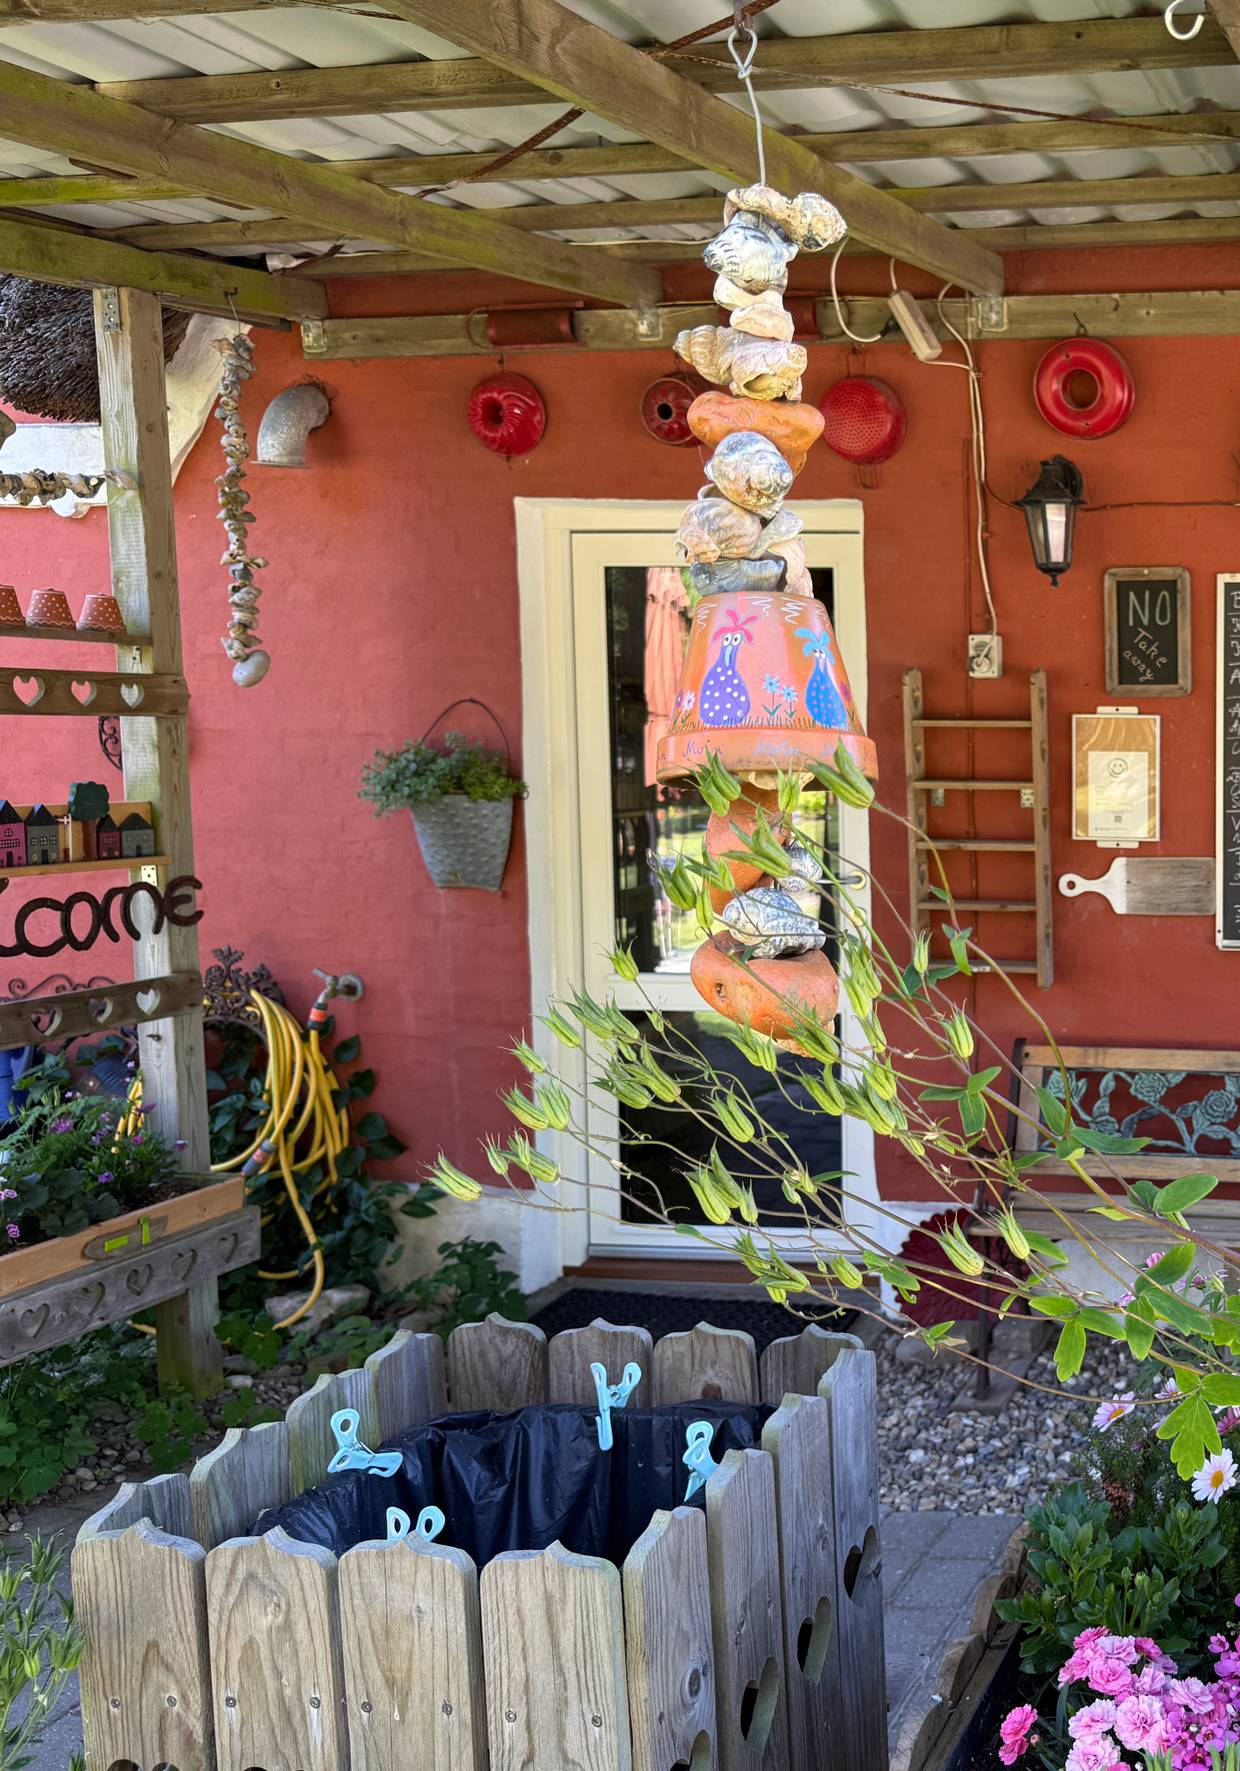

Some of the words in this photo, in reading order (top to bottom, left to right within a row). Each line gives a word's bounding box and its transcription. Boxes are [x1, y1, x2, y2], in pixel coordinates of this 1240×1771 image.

[1128, 590, 1171, 626] NO
[1123, 650, 1154, 682] away
[1134, 628, 1167, 668] Take
